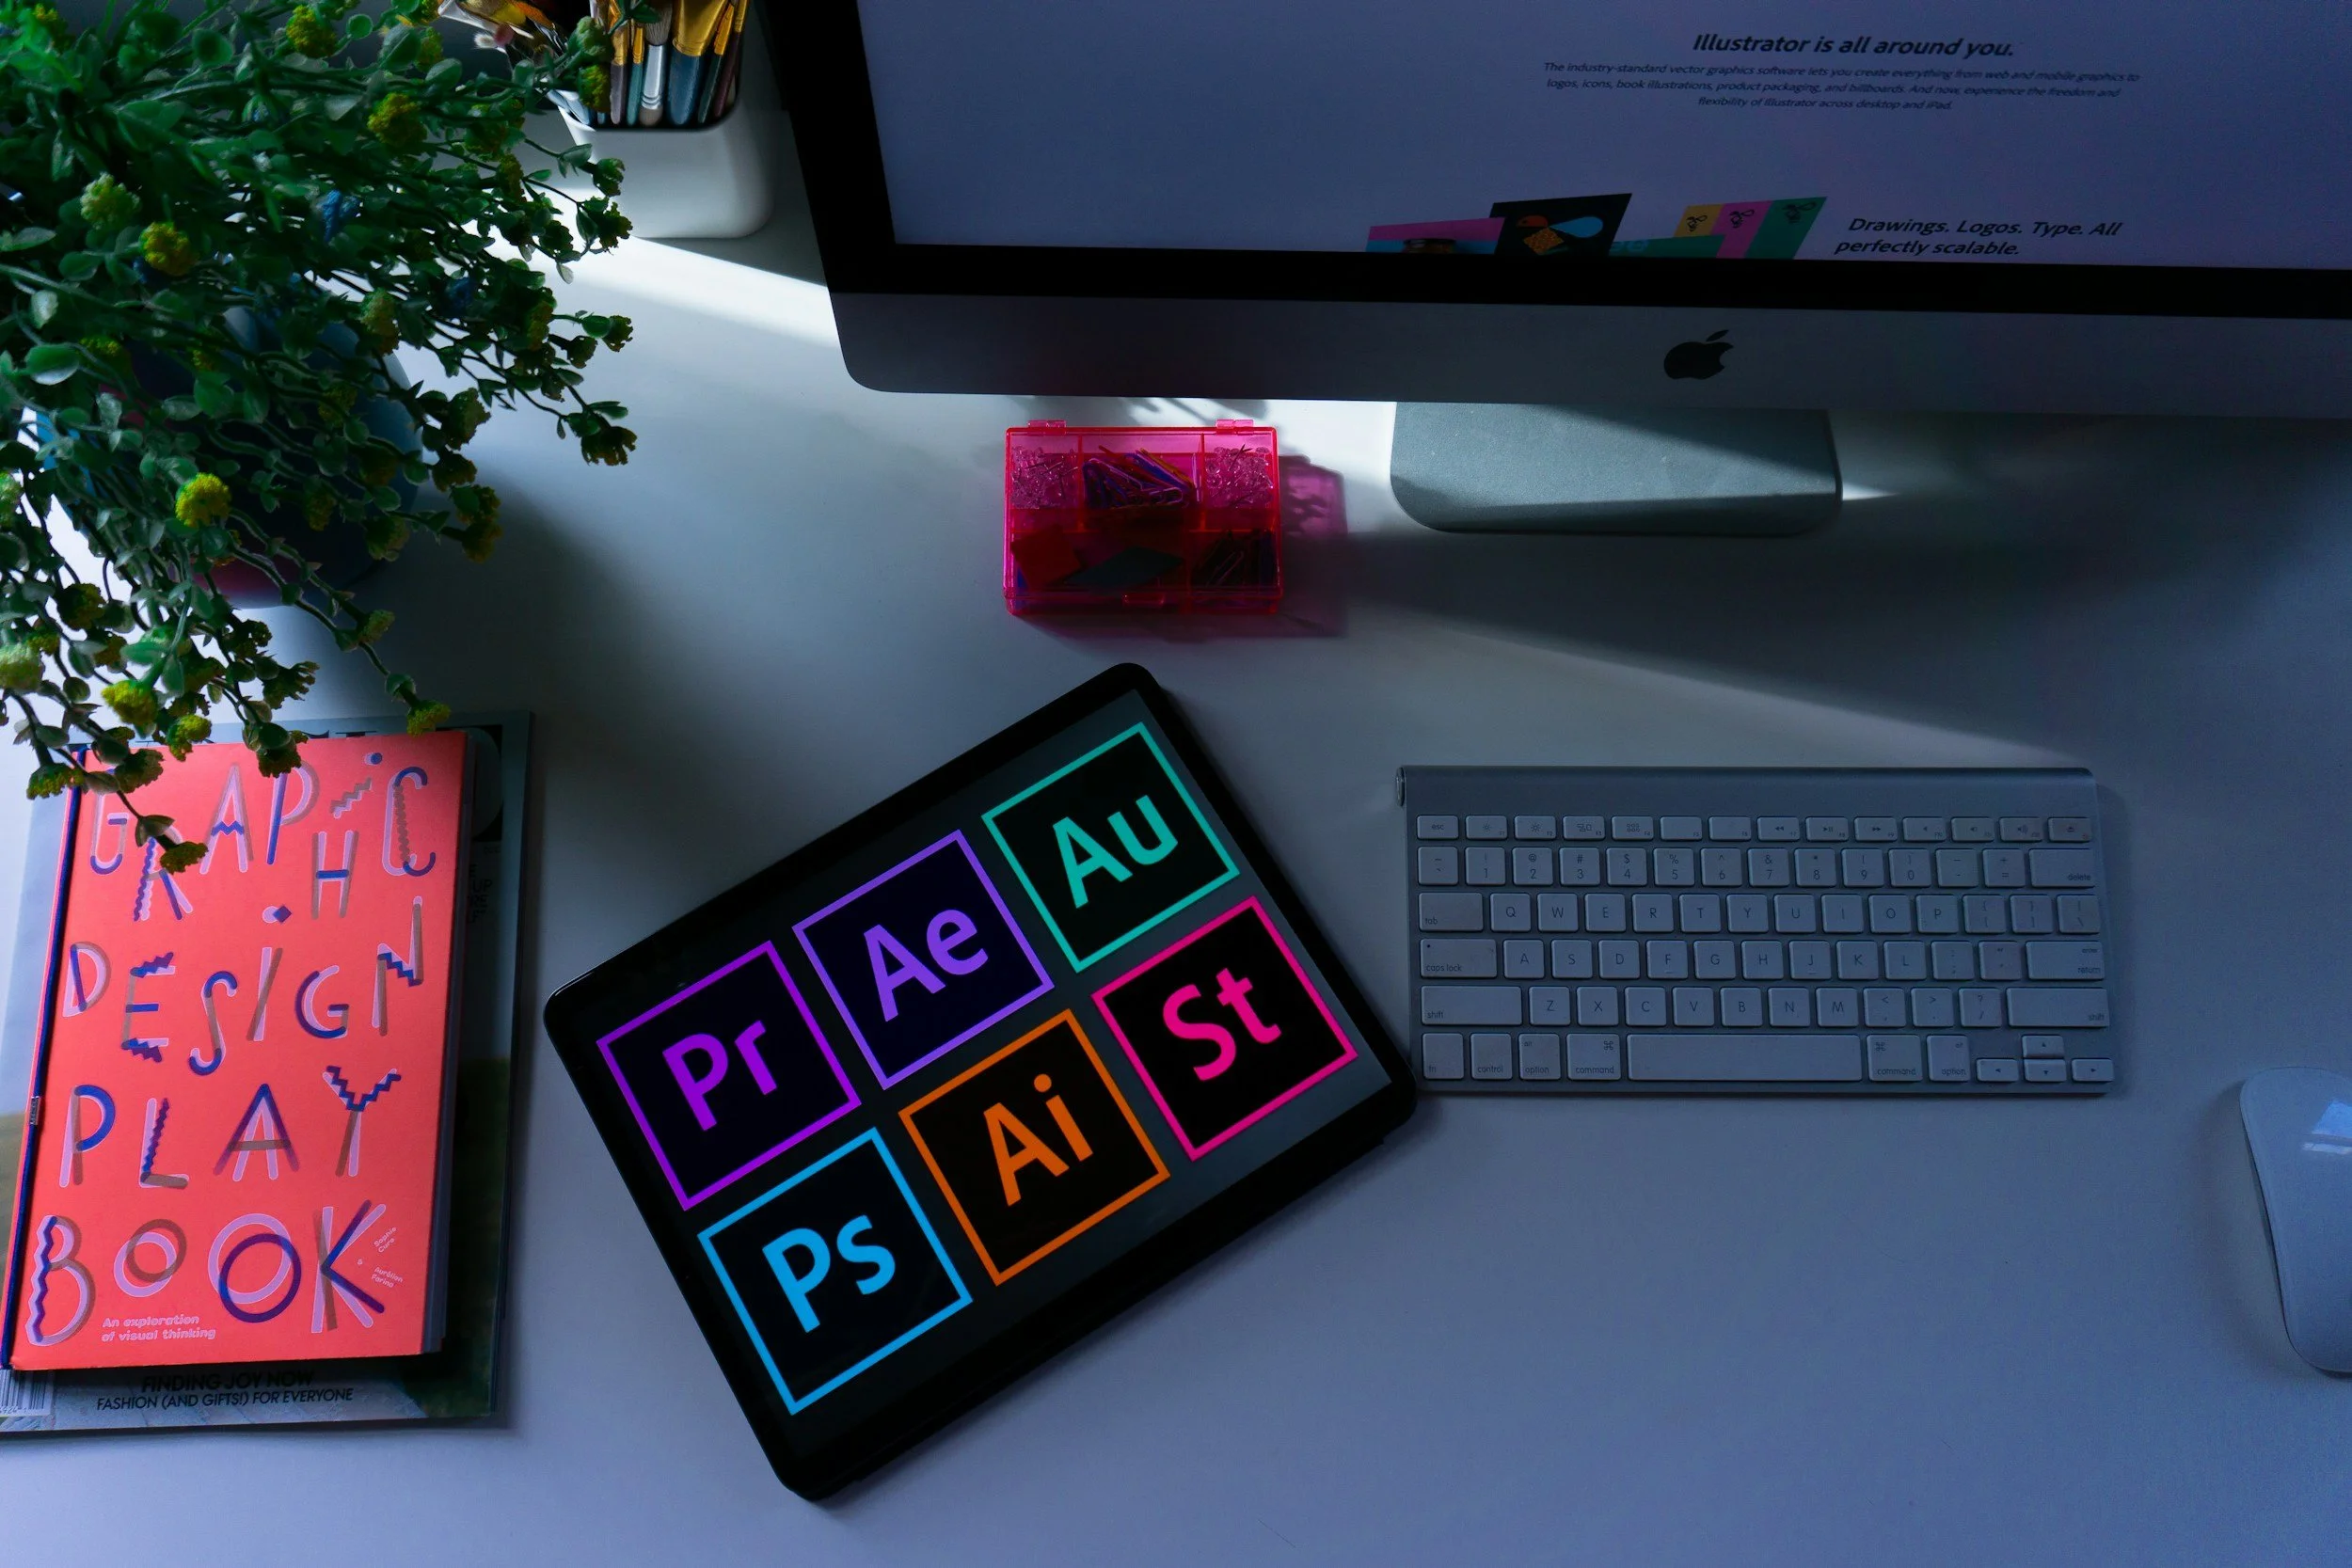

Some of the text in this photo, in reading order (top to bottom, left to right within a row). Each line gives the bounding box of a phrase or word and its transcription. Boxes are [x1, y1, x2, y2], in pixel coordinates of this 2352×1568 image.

[1692, 34, 2014, 59] Illustrator is all around you.
[1544, 62, 2140, 83] The industry-standard vector graphics software lets you create everything from web and mobile graphics to
[1547, 79, 2121, 97] logos, icons, book illustrations, product packaging, and billboards. And now, experience the freedom and
[1697, 96, 1748, 107] flexibility
[1751, 97, 1762, 106] of
[1764, 97, 1818, 107] Illustrator
[1855, 99, 1900, 110] desktop
[1902, 100, 1925, 109] and
[1926, 101, 1952, 110] iPad.
[1848, 218, 2123, 238] Drawings. Logos. Type. All
[1835, 240, 2019, 256] perfectly scalable.
[89, 752, 437, 923] GRAPHIC
[1051, 793, 1179, 910] Au
[1530, 869, 1536, 879] 2
[1578, 869, 1583, 879] 3
[1624, 869, 1630, 879] 4
[1672, 870, 1677, 879] 5
[1719, 870, 1725, 879] 6
[1767, 870, 1772, 879] 7
[1814, 870, 1820, 879] 8
[1861, 871, 1867, 880] 9
[1908, 871, 1915, 880] 0
[2068, 873, 2090, 881] delete
[1506, 907, 1516, 918] Q
[1552, 907, 1564, 917] W
[1602, 907, 1609, 918] E
[1650, 908, 1657, 918] R
[1696, 908, 1703, 918] T
[1744, 908, 1751, 918] Y
[1792, 908, 1800, 918] U
[1886, 909, 1896, 919] O
[1934, 909, 1942, 919] P
[863, 908, 991, 1022] Ae
[1519, 954, 1529, 964] A
[1568, 954, 1575, 965] S
[1616, 954, 1624, 965] D
[1665, 955, 1671, 965] F
[1710, 955, 1720, 965] G
[1759, 955, 1768, 965] H
[1808, 955, 1814, 966] J
[1854, 956, 1862, 965] K
[1902, 956, 1909, 966] L
[62, 895, 424, 1076] DESIGN
[1547, 1001, 1553, 1011] Z
[1594, 1002, 1603, 1012] X
[1642, 1002, 1649, 1012] C
[1690, 1002, 1698, 1012] V
[1739, 1002, 1745, 1012] B
[1786, 1002, 1794, 1012] N
[1833, 1002, 1844, 1012] M
[1161, 966, 1283, 1083] St
[662, 1016, 778, 1132] Pr
[1525, 1066, 1549, 1075] option
[1942, 1068, 1966, 1076] option
[58, 1065, 402, 1189] PLAY
[981, 1071, 1095, 1207] Ai
[373, 1227, 397, 1247] Sophie
[24, 1199, 387, 1347] BOOK
[760, 1212, 898, 1334] Ps
[103, 1314, 199, 1328] An exploration
[102, 1327, 215, 1342] of visual thinking
[141, 1370, 314, 1393] FINDING JOY NOW
[97, 1387, 354, 1411] FASHION (AND GIFTS!) FOR EVERYONE
